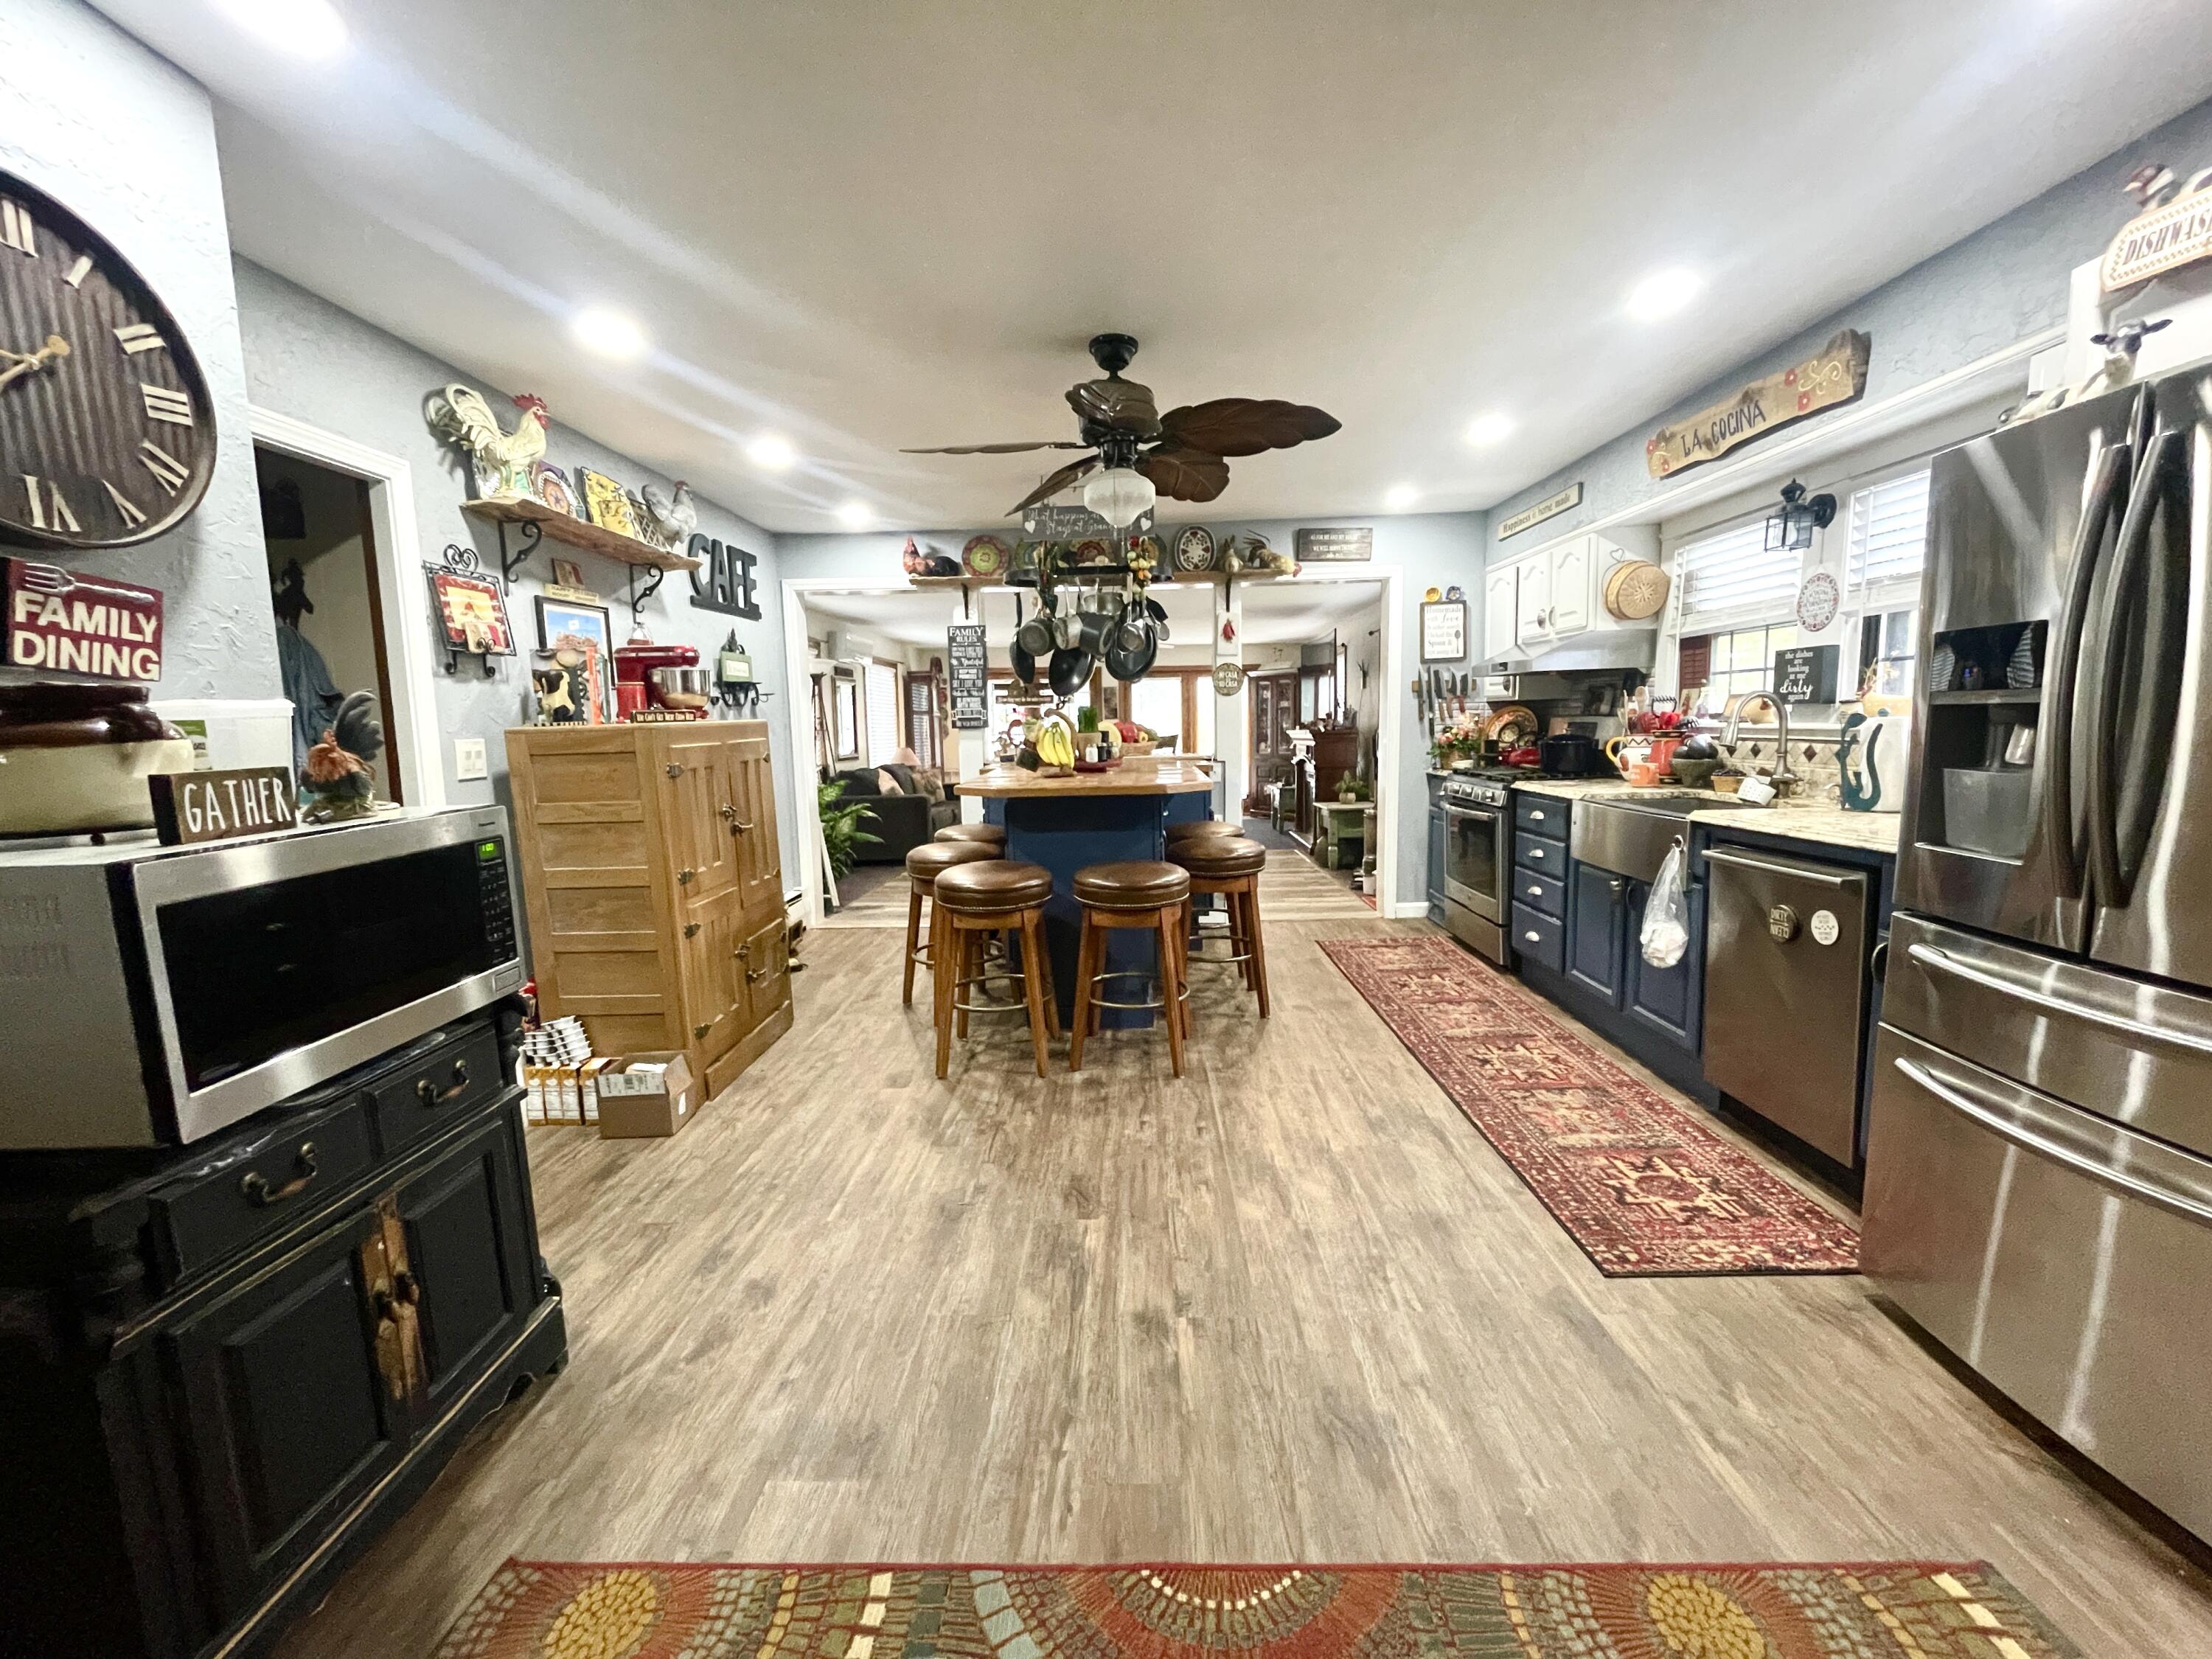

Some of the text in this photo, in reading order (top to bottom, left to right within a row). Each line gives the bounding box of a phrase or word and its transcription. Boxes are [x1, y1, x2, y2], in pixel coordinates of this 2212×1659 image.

[1682, 400, 1766, 457] LA COCINA
[1503, 515, 1531, 533] Happiness
[688, 533, 761, 621] CAFE
[15, 590, 159, 643] FAMILY
[949, 627, 984, 636] FAMILY
[13, 630, 160, 681] DINING
[1779, 678, 1814, 700] dirty
[184, 777, 292, 833] GATHER
[1770, 908, 1789, 922] DIRTY
